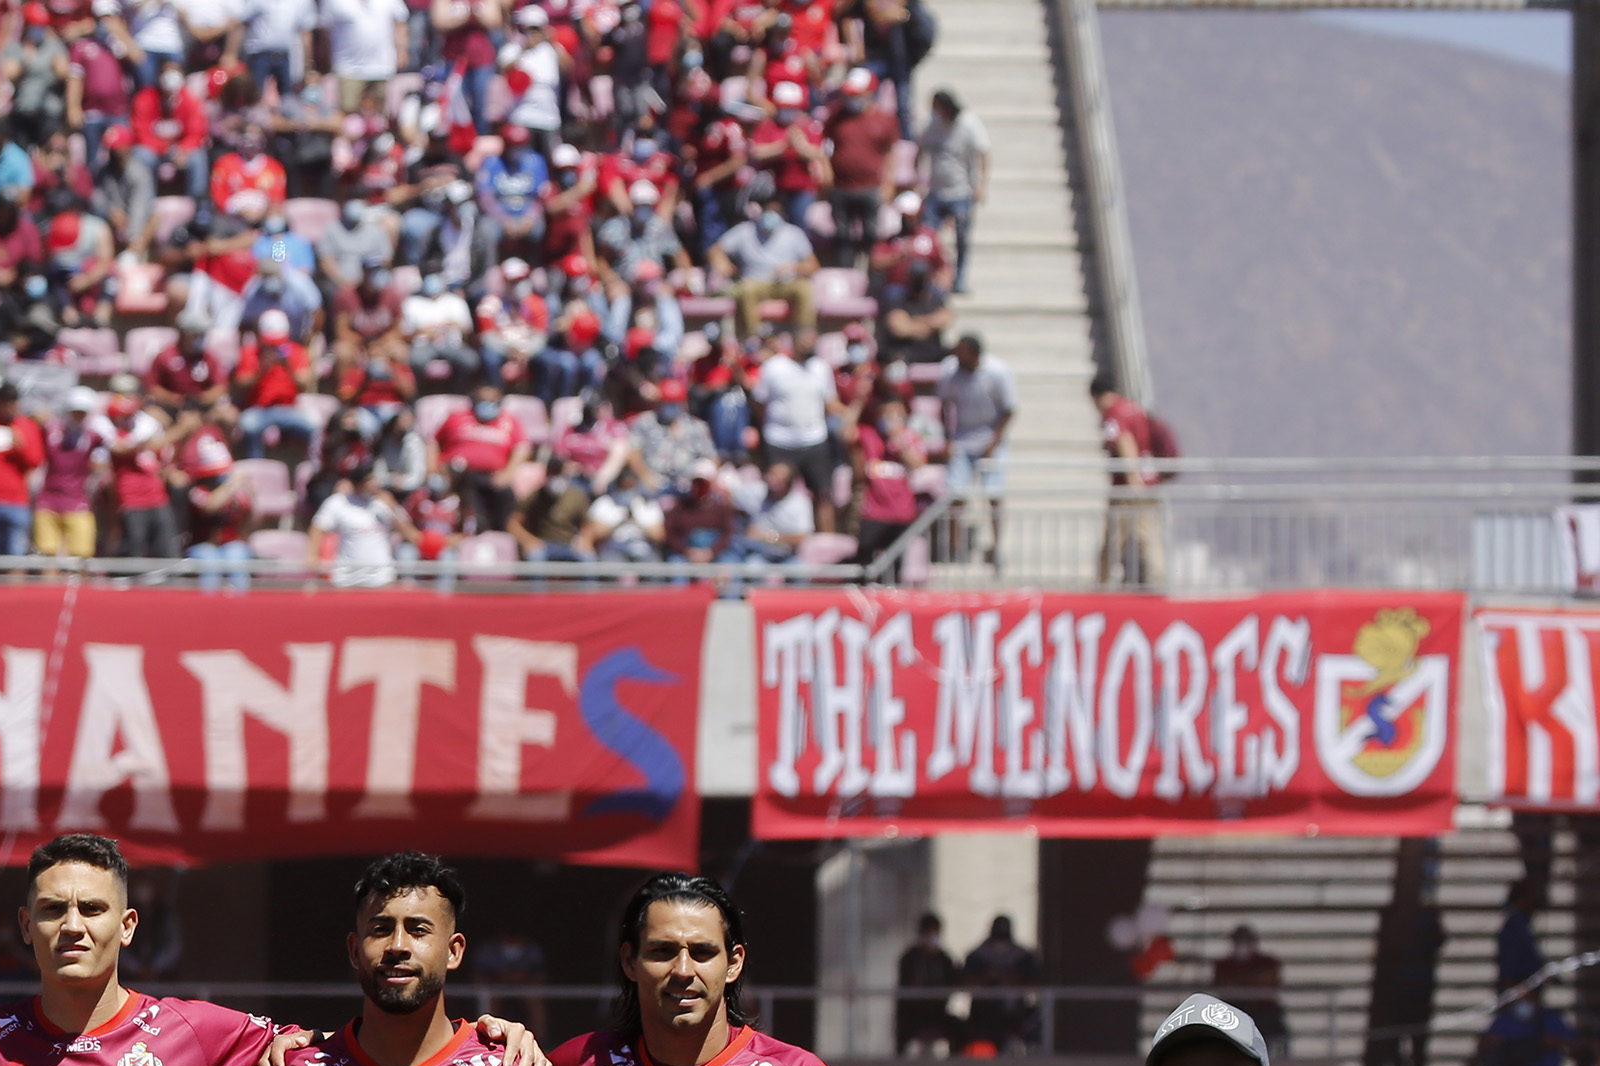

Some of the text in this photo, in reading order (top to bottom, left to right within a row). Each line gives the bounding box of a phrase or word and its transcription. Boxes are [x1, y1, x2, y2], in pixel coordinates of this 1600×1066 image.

[762, 607, 1313, 802] THE MENORES
[66, 1041, 102, 1053] MEDS
